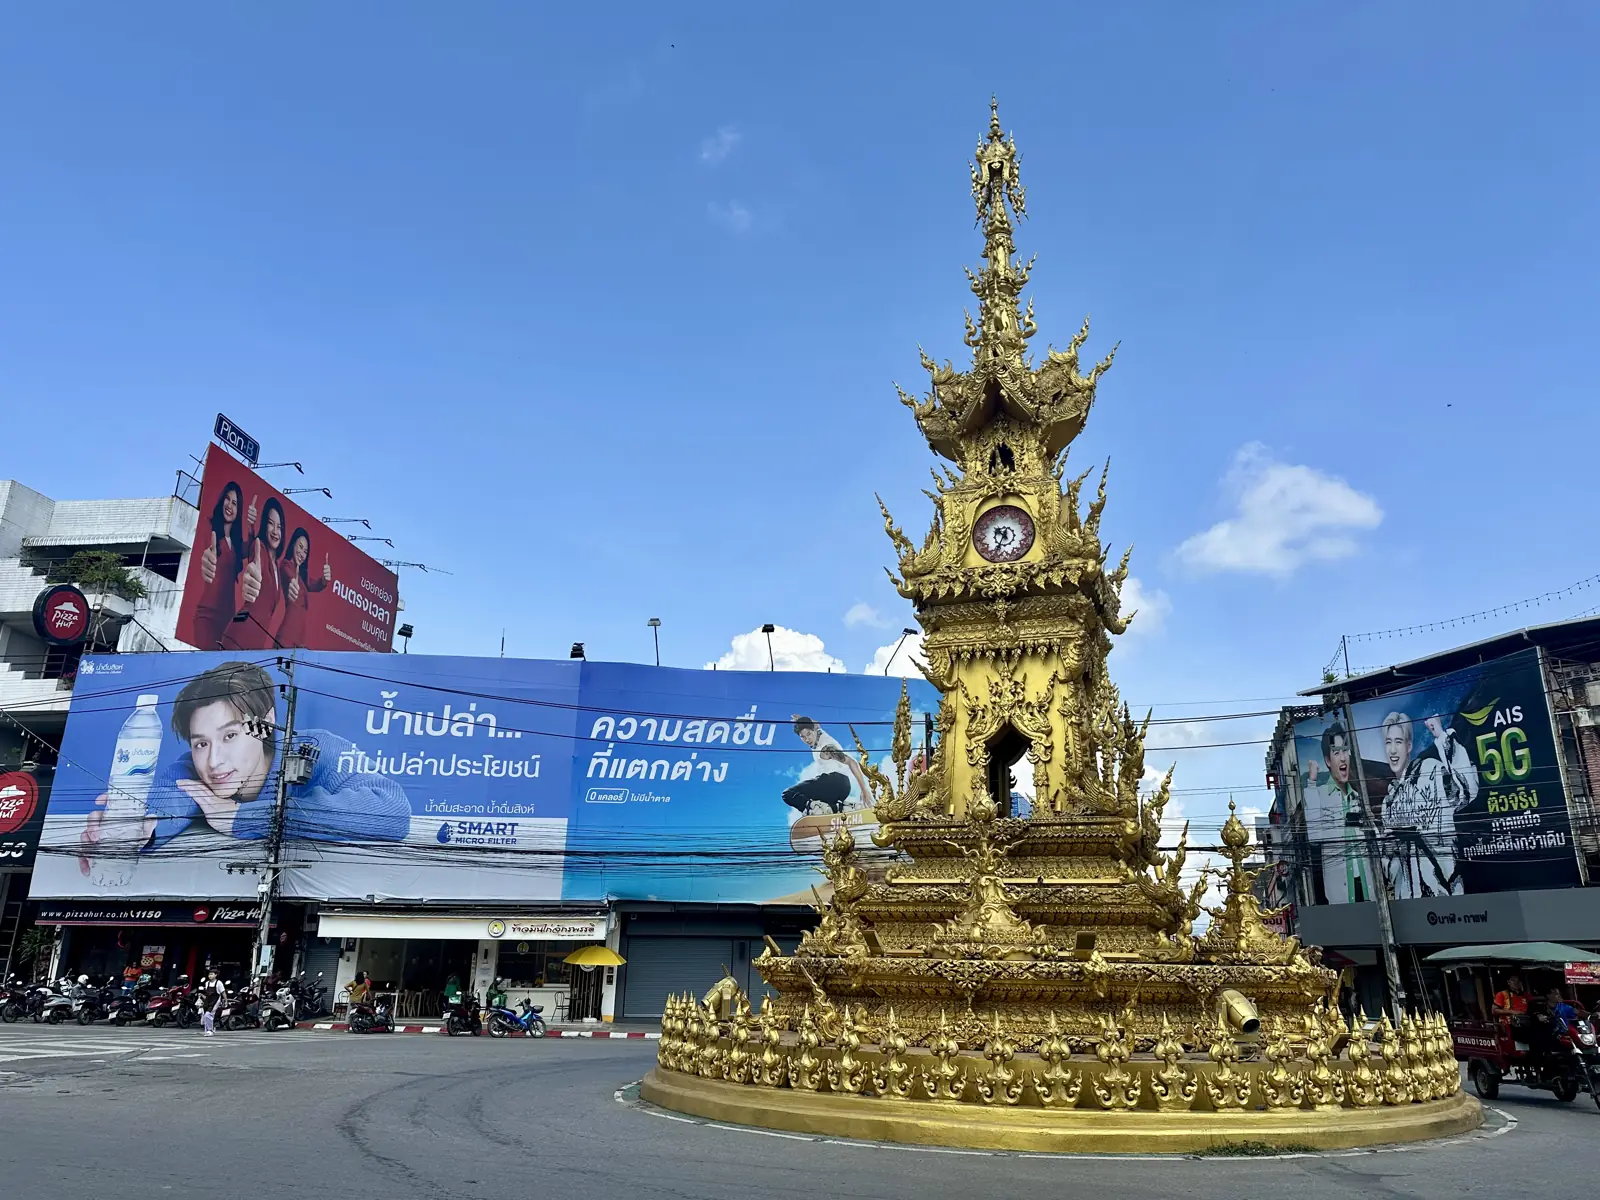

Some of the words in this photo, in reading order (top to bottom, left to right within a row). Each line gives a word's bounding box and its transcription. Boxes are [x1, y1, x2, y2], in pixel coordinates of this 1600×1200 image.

[361, 576, 393, 604] ขอยกย่อง
[332, 580, 390, 625] คนตรงเวลา
[51, 610, 79, 622] Pizza
[55, 619, 75, 629] Hut
[361, 619, 388, 642] แบบคุณ
[366, 690, 522, 738] น้ำเปล่า...
[1493, 705, 1524, 728] AIS
[590, 704, 777, 746] ความสดชื่น
[336, 743, 541, 778] ที่ไม่เปล่าประโยชน์
[586, 743, 729, 783] ที่แตกต่าง
[1475, 727, 1532, 785] 5G
[0, 798, 24, 810] izza
[590, 791, 596, 801] 0
[597, 790, 624, 801] แคลอรี่
[630, 791, 671, 803] ไม่มีน้ำตาล
[1487, 786, 1539, 814] ตัวจริง
[0, 807, 20, 818] ut
[425, 799, 484, 813] น้ำดื่มสะอาด
[487, 800, 535, 814] น้ำดื่มสิงห์
[457, 822, 519, 836] SMART
[455, 837, 485, 845] MICRO
[41, 909, 129, 919] www.pizzahut.co.th
[135, 910, 162, 919] 1150
[212, 906, 246, 921] Pizza
[246, 907, 263, 920] Hu
[1463, 910, 1488, 924] กาแฟ
